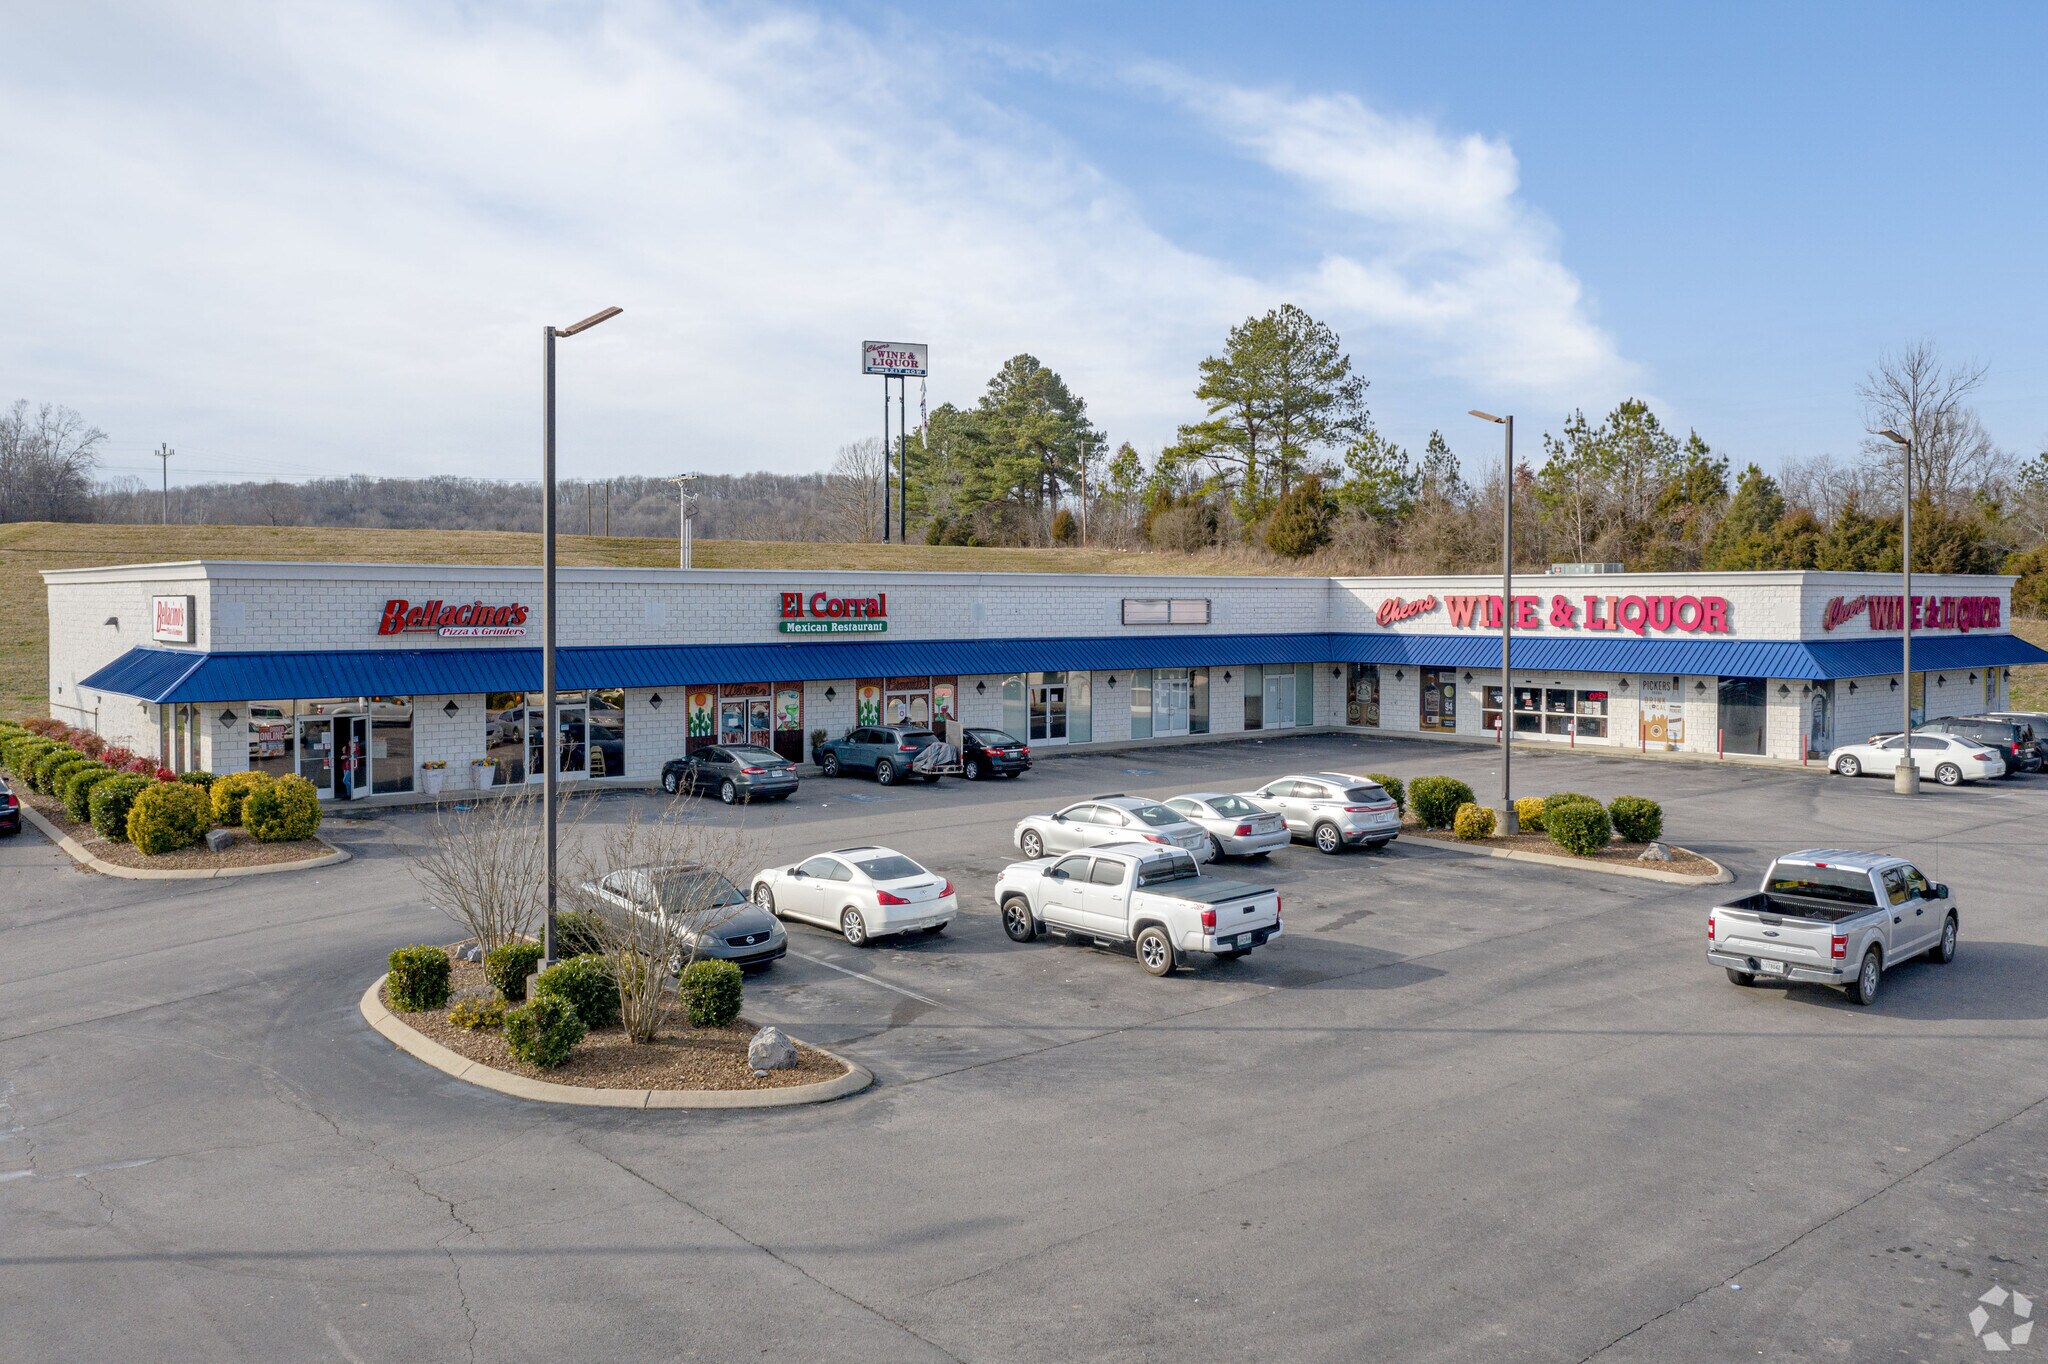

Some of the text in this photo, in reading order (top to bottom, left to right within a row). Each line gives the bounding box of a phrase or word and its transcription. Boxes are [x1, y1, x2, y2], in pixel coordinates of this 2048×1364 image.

[866, 344, 890, 353] Cheers
[877, 351, 916, 360] WINE &
[872, 358, 918, 367] LIQUOR
[780, 591, 888, 618] El Corral
[156, 601, 184, 633] Bellacino's
[378, 599, 529, 636] Bellacino's
[1376, 594, 1730, 635] Cheers WINE & LIQUOR
[1823, 594, 1868, 633] Cheers
[1925, 595, 1940, 628] &
[1940, 595, 2000, 633] LIQUOR
[442, 628, 525, 636] Pizza & Grinders
[786, 622, 883, 632] Mexican Restaurant
[1642, 680, 1671, 691] PICKERS
[1589, 691, 1607, 700] OPEN
[260, 732, 284, 740] ONLINE
